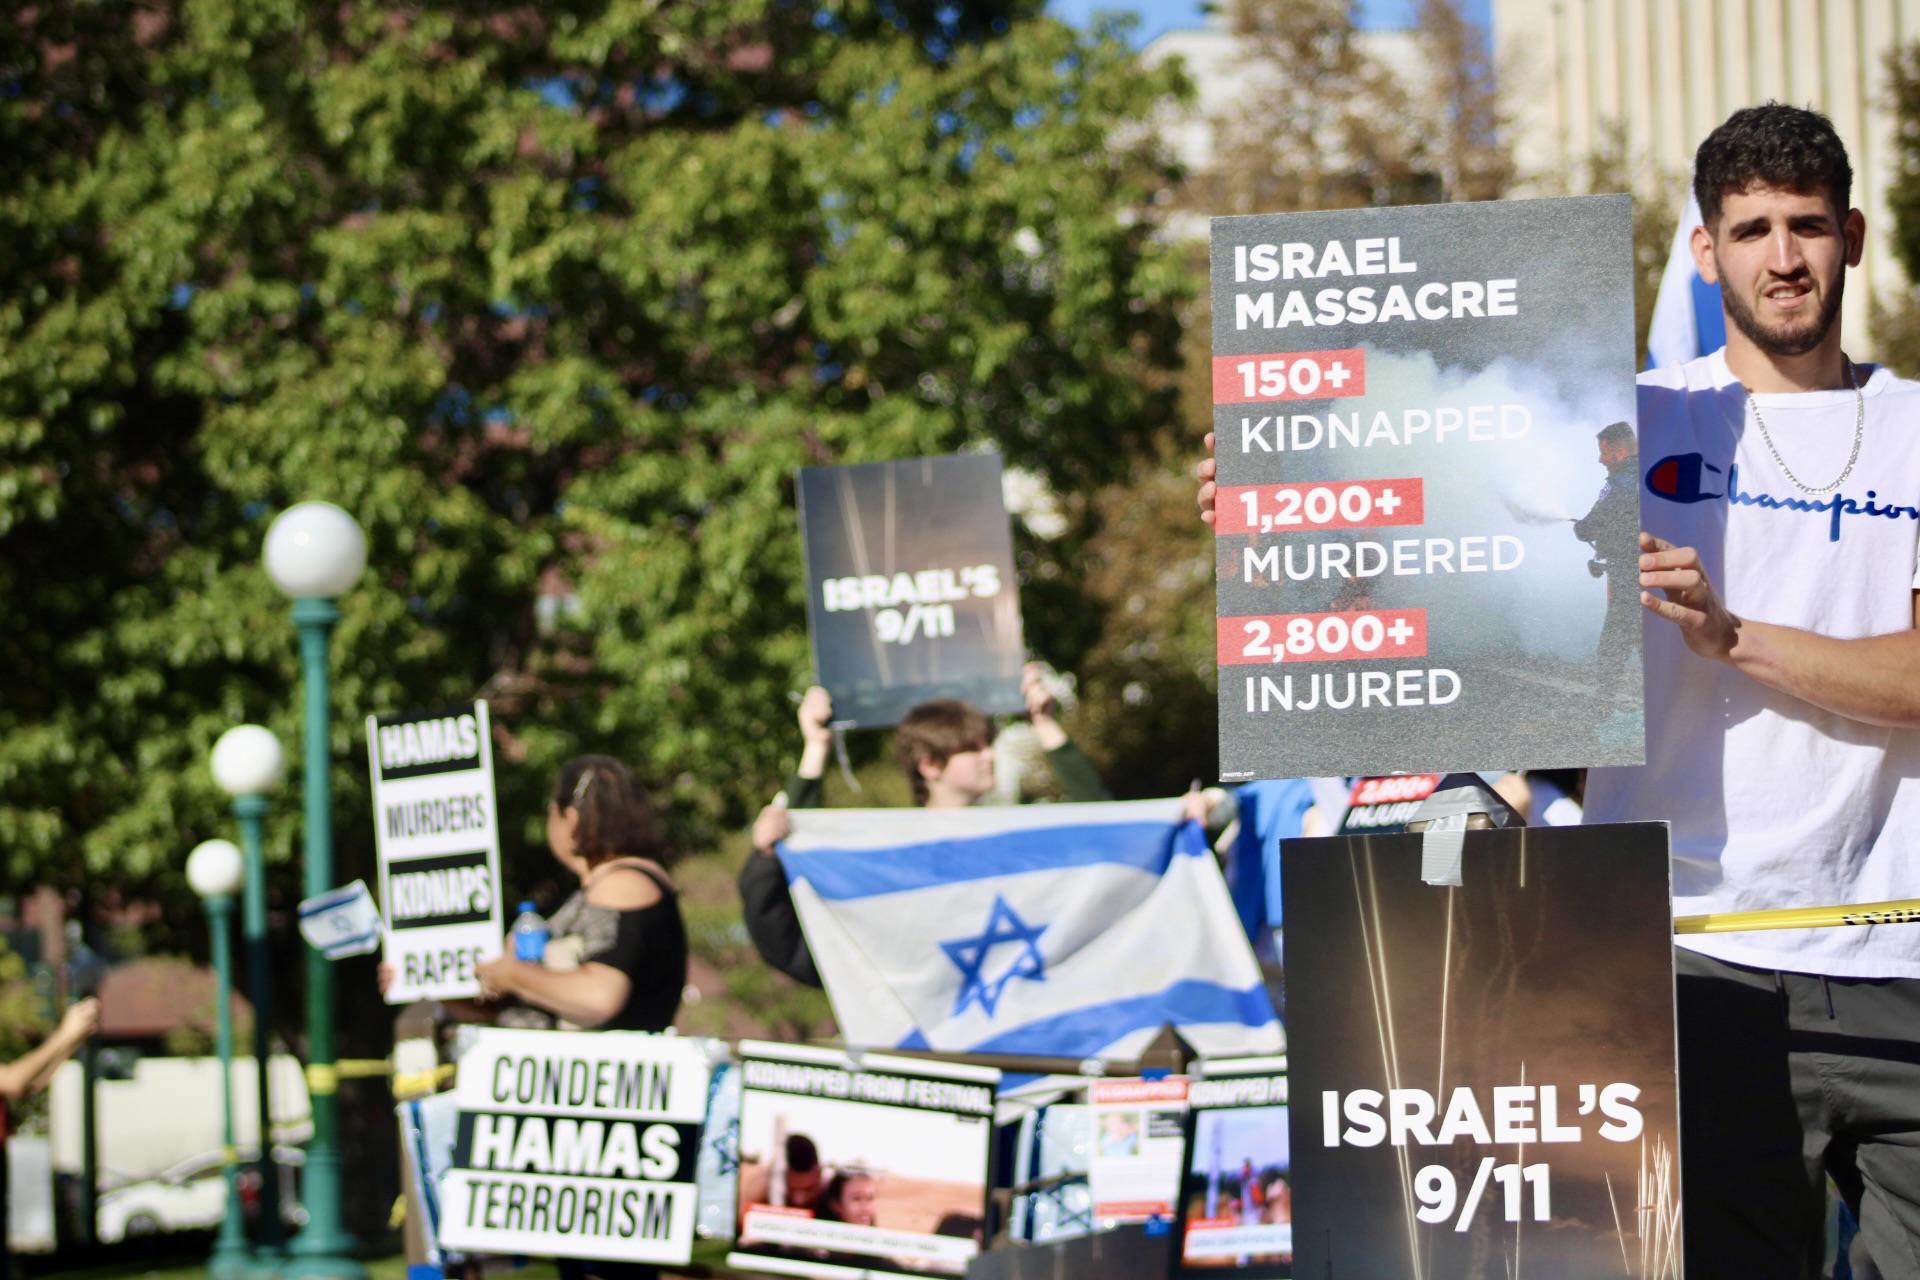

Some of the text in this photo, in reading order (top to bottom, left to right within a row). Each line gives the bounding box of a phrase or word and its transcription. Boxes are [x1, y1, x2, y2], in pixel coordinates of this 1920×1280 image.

[1234, 237, 1417, 282] ISRAEL
[1235, 279, 1518, 331] MASSACRE
[1237, 359, 1351, 397] 150+
[1241, 404, 1532, 453] KIDNAPPED
[1239, 486, 1401, 533] 1,200+
[1243, 535, 1525, 583] MURDERED
[822, 564, 1001, 612] ISRAEL'S
[875, 604, 955, 645] 9/11
[1243, 615, 1414, 663] 2,800+
[1246, 668, 1461, 713] INJURED
[379, 714, 478, 769] HAMAS
[386, 793, 487, 839] MURDERS
[1345, 800, 1424, 829] INJURE
[391, 864, 491, 920] KIDNAPS
[492, 1056, 672, 1112] CONDEMN
[744, 1060, 993, 1113] KIDNAPPED FROM FESTIVAL
[1322, 1082, 1644, 1148] ISRAEL'S
[470, 1113, 681, 1181] HAMAS
[466, 1180, 674, 1240] TERRORISM
[1414, 1157, 1551, 1233] 9/11
